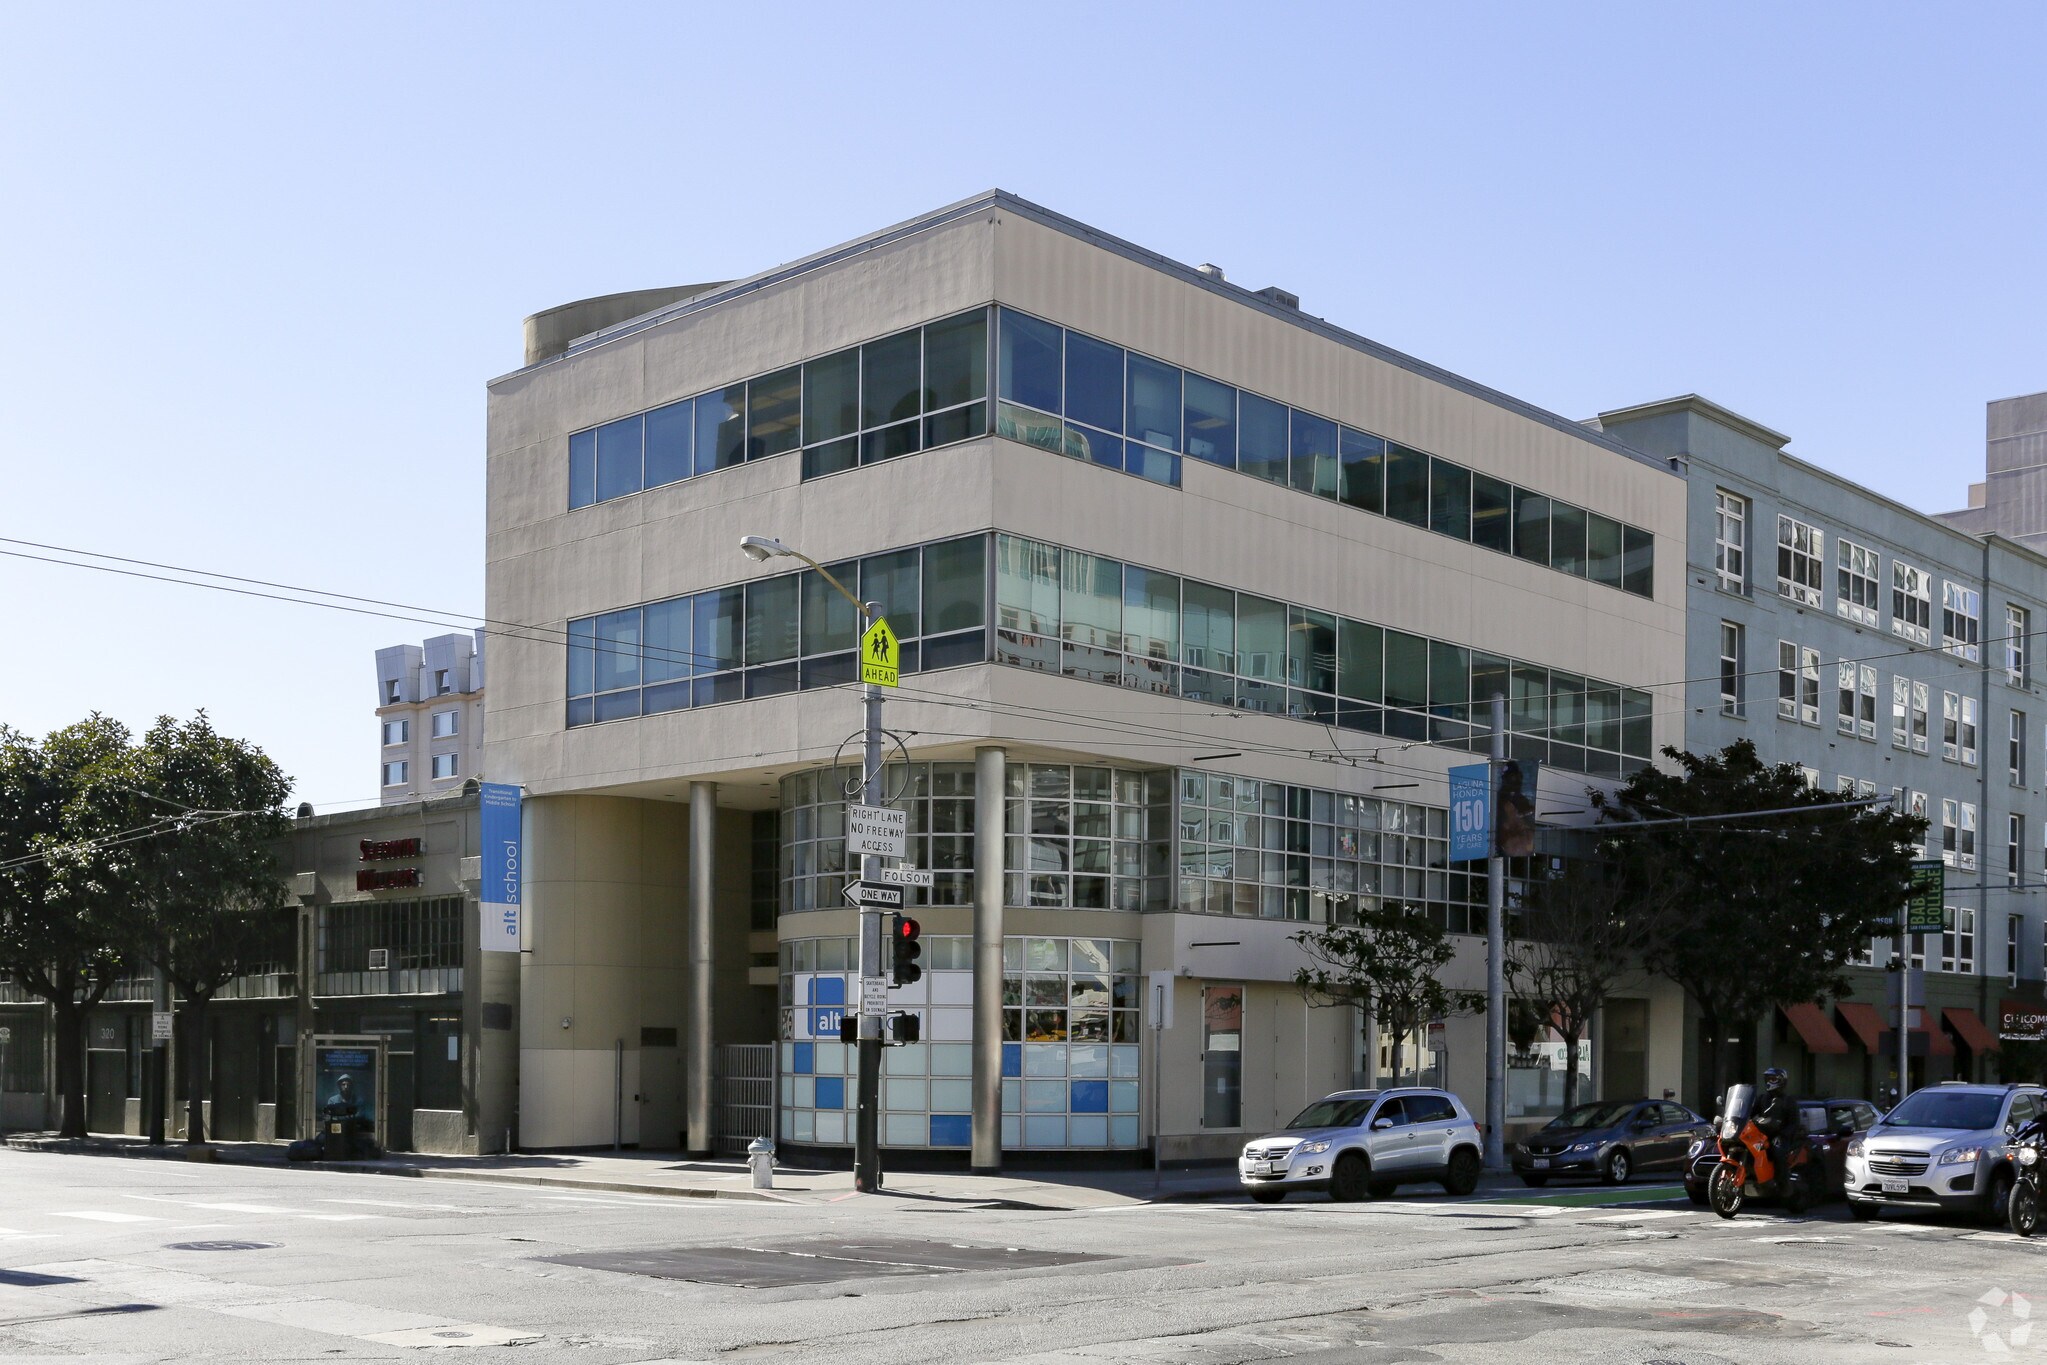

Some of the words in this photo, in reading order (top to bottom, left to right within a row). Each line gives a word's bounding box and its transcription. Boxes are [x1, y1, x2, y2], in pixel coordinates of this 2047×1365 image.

[865, 668, 896, 683] AHEAD
[1452, 780, 1484, 791] LAGUNA
[1452, 788, 1484, 799] HONDA
[852, 808, 879, 821] RIGHT
[881, 812, 903, 824] LANE
[1452, 799, 1484, 832] 150
[851, 822, 864, 834] NO
[866, 825, 904, 839] FREEWAY
[1456, 833, 1483, 843] YEARS
[861, 840, 893, 852] ACCESS
[1467, 841, 1483, 849] CARE
[503, 840, 517, 904] school
[884, 871, 930, 884] FOLSOM
[861, 888, 878, 900] ONE
[880, 890, 898, 902] WAY
[1910, 869, 1926, 925] BABON
[1927, 869, 1941, 925] COLLEGE
[503, 910, 517, 936] alt
[819, 1010, 841, 1031] alt
[101, 1027, 115, 1040] 320
